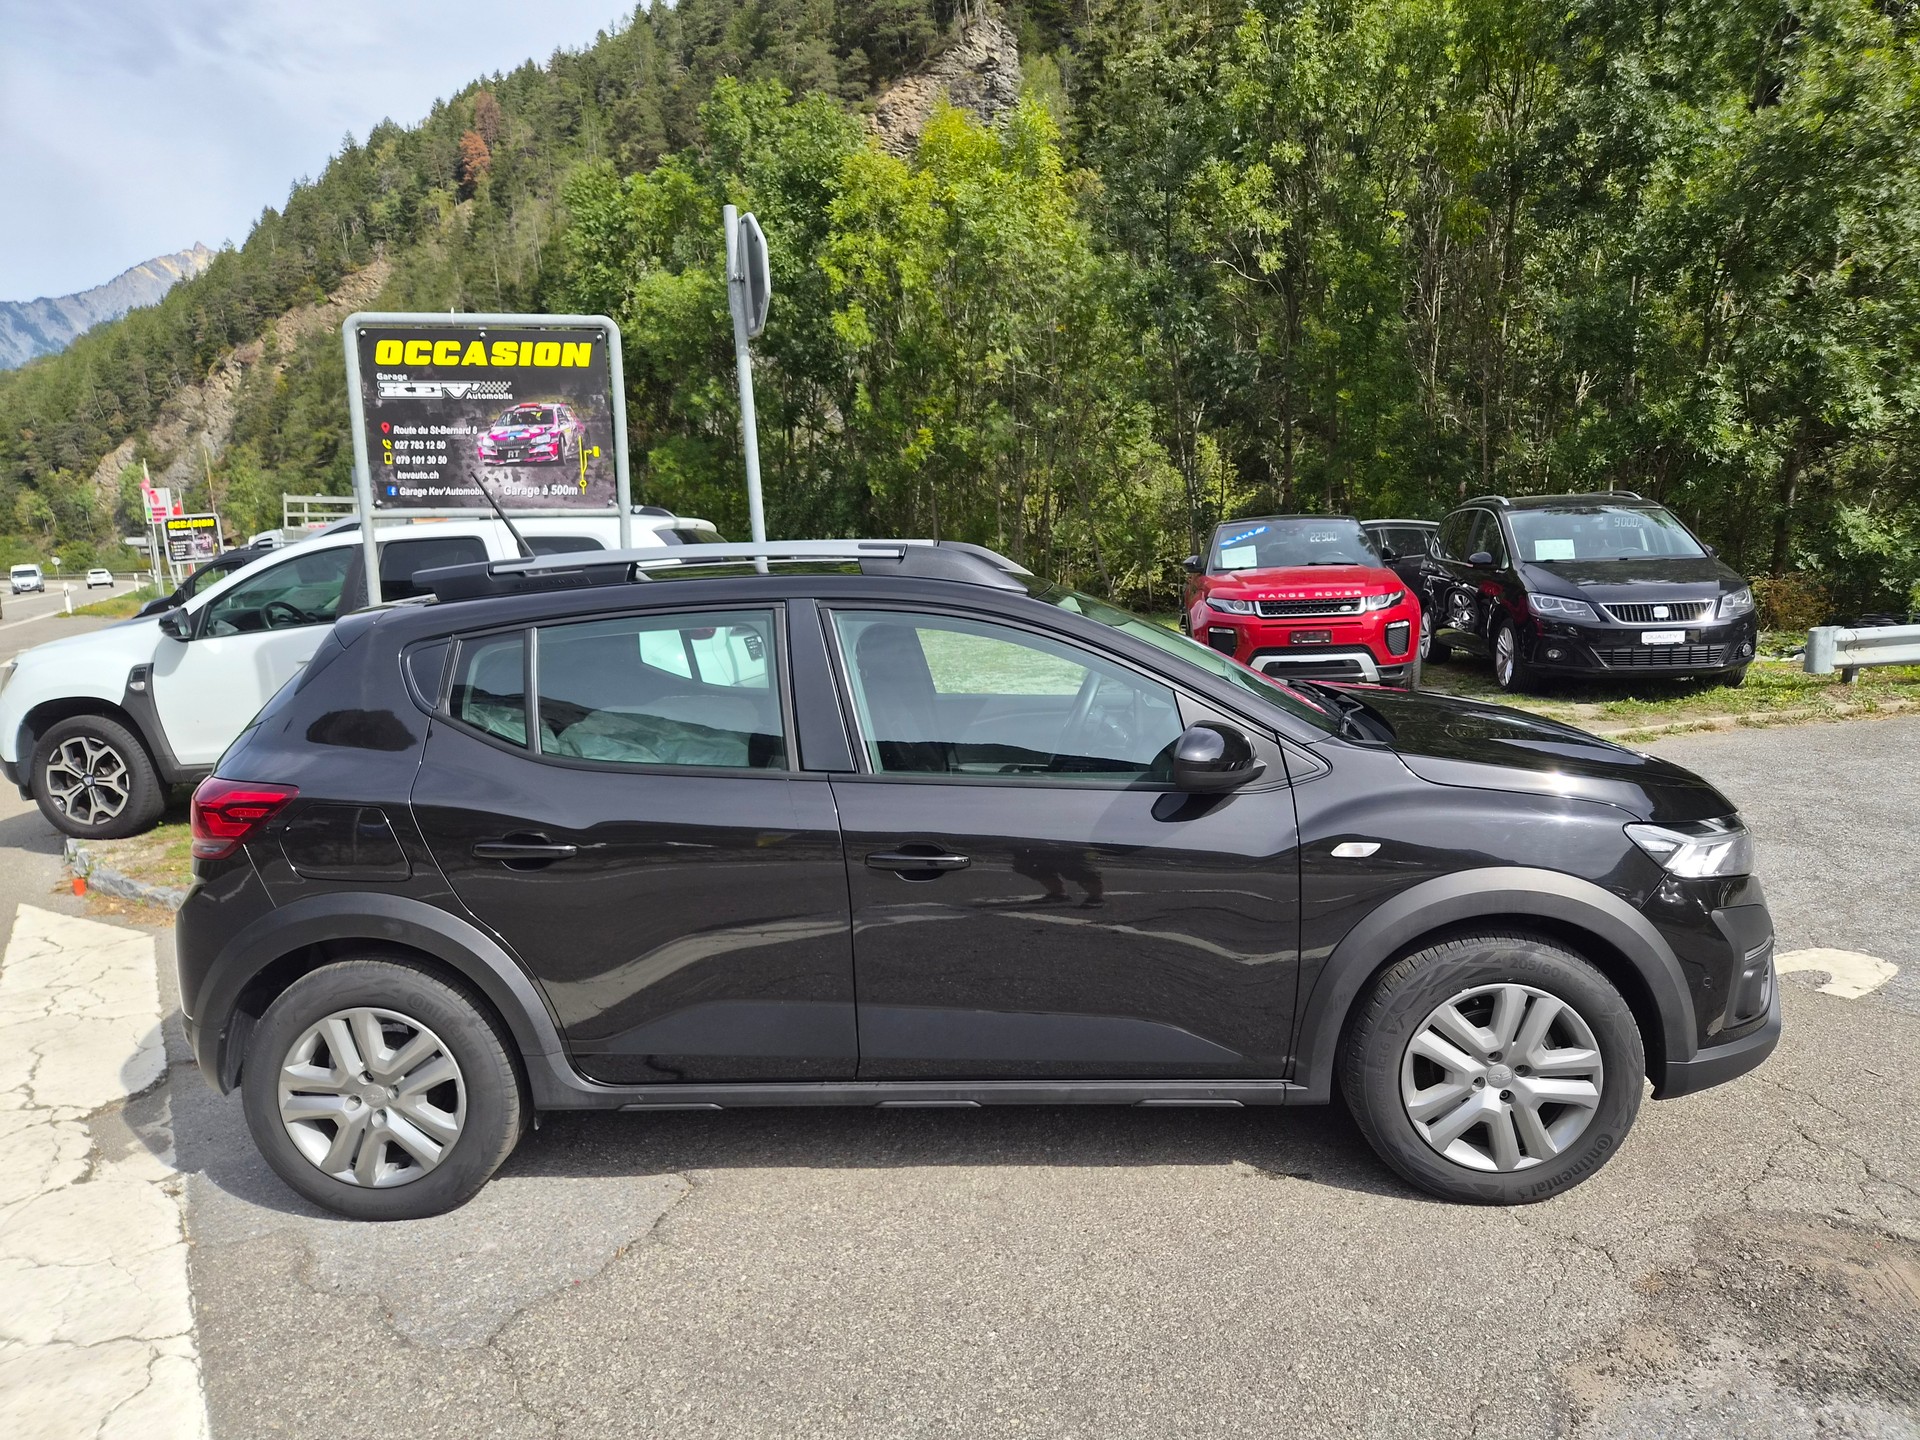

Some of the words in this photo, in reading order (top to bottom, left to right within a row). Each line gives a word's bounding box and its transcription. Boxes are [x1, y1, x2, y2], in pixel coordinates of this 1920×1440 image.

[374, 339, 592, 368] OCCASION
[376, 372, 408, 382] Garage
[466, 391, 514, 401] Automobile
[393, 424, 417, 435] Route
[417, 425, 429, 435] du
[429, 425, 471, 435] St-Bernard
[394, 440, 409, 450] 027
[425, 440, 436, 450] 12
[395, 455, 411, 465] 079
[411, 455, 426, 465] 101
[426, 455, 437, 465] 30
[397, 470, 440, 480] kevauto.ch
[399, 486, 428, 498] Garage
[428, 486, 493, 496] Kev'Automobils
[503, 485, 541, 498] Garage
[542, 484, 549, 496] à
[551, 484, 578, 496] 500m
[1509, 957, 1561, 978] 205/60
[1528, 1133, 1614, 1197] Continental
